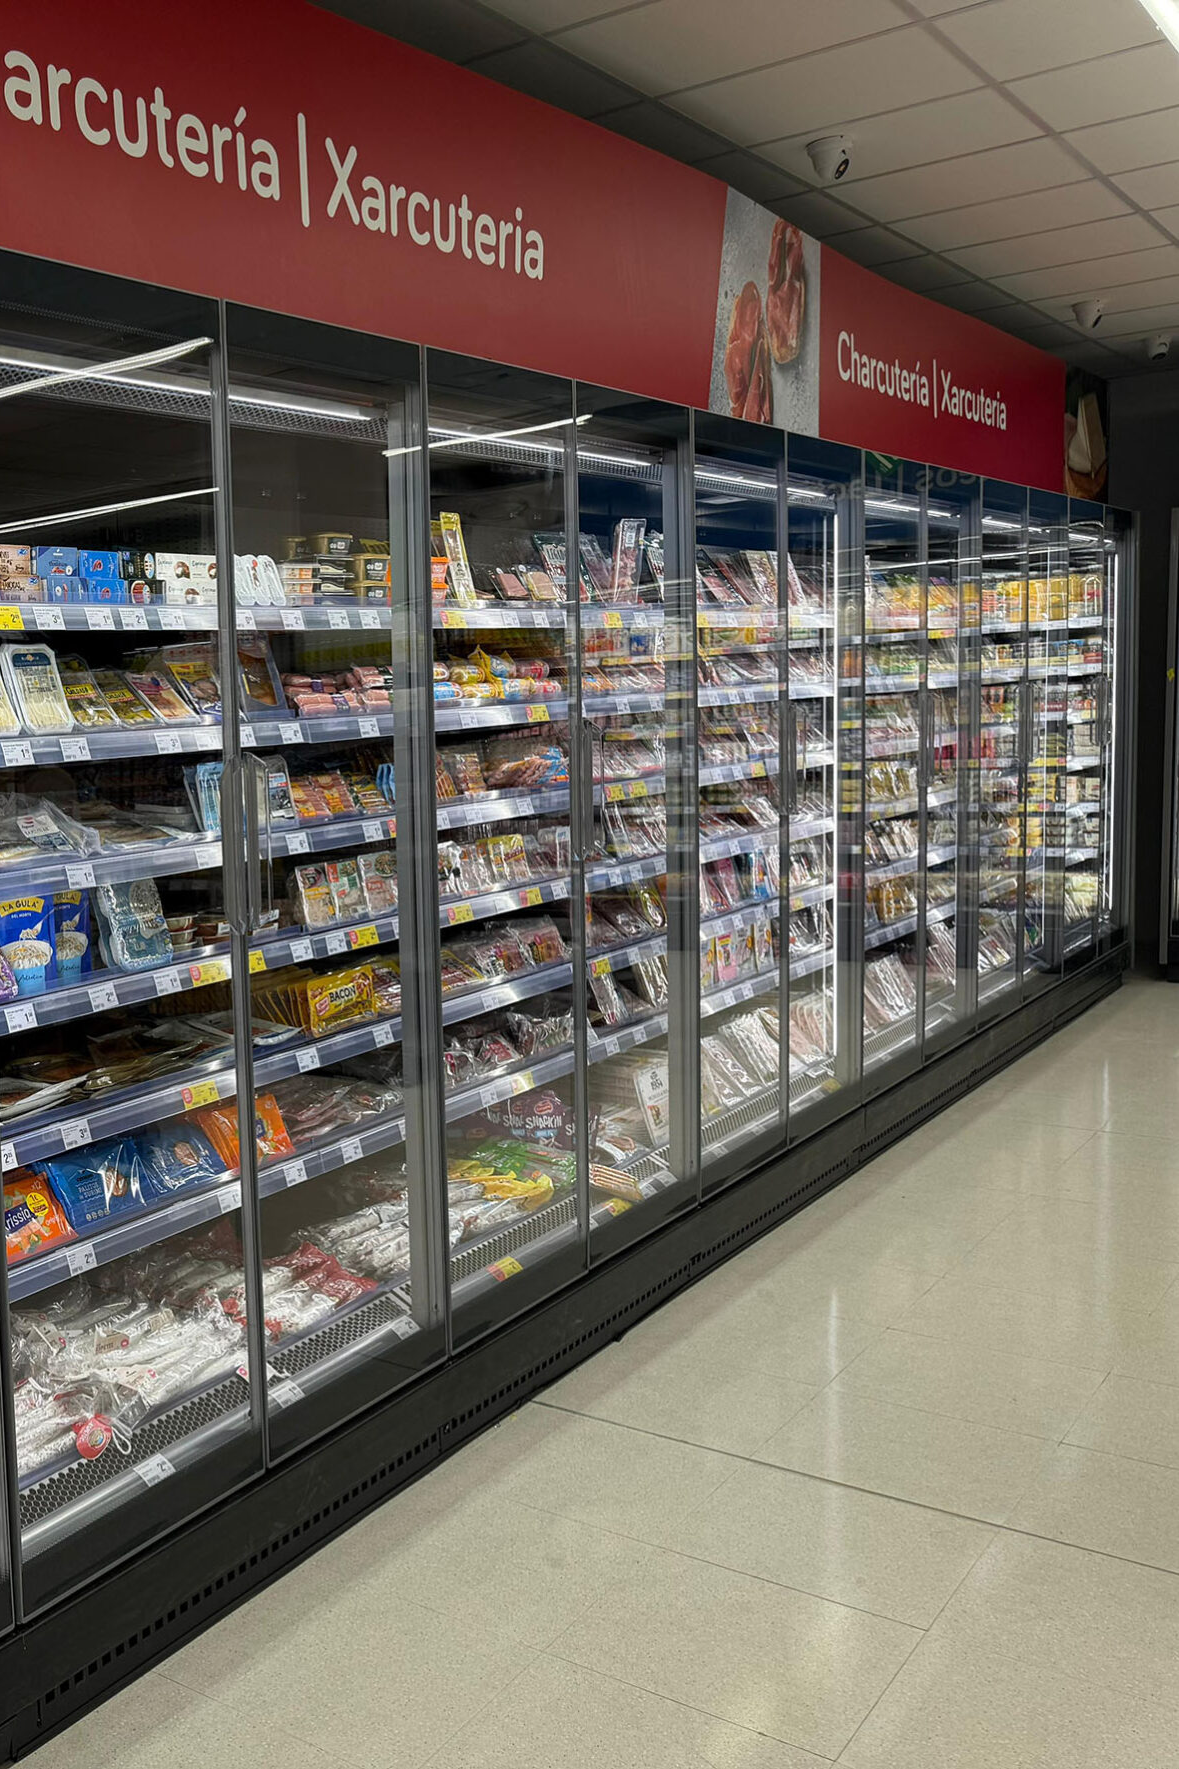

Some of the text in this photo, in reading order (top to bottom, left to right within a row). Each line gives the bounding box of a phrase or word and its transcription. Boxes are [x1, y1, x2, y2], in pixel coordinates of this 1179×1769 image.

[324, 136, 545, 281] Xarcuteria
[837, 330, 929, 407] Charcutería
[941, 369, 1007, 431] Xarcuteria
[16, 900, 37, 908] GULA
[329, 985, 356, 1002] BACON
[5, 1207, 32, 1231] rissia
